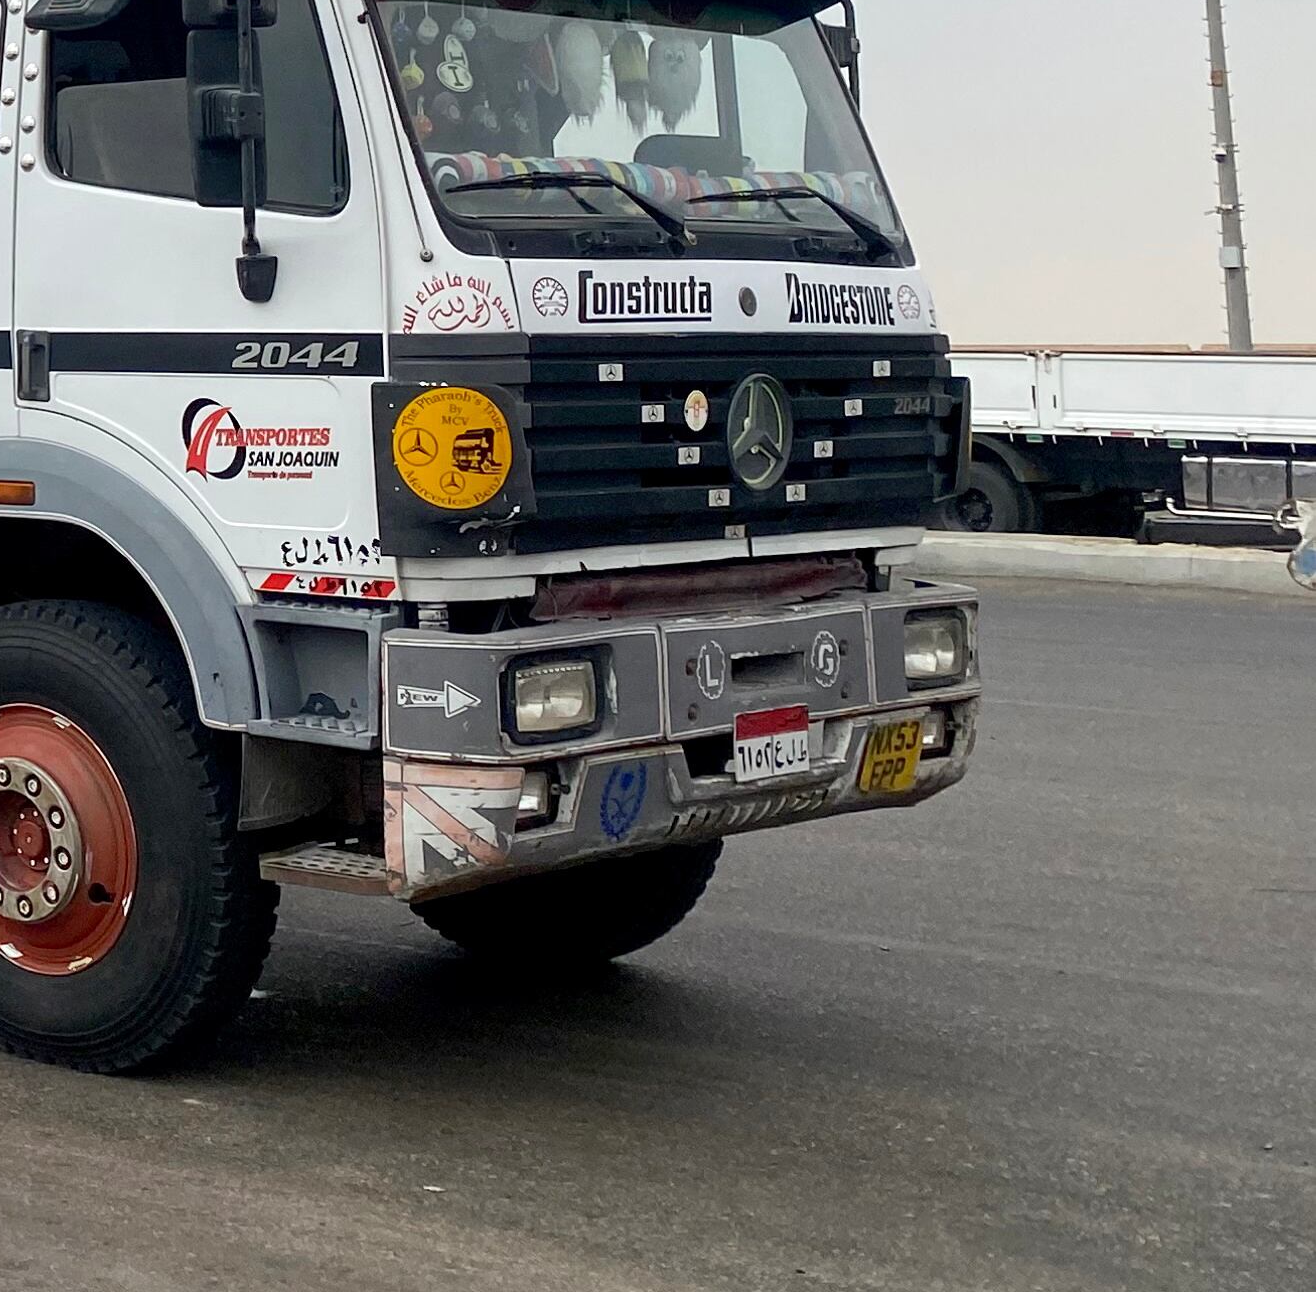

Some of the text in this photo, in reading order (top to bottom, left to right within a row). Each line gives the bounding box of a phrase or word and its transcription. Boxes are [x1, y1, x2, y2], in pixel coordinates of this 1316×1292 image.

[578, 270, 712, 324] Constructa
[785, 272, 895, 326] BRIDGESTONE
[231, 341, 359, 369] 2044
[401, 391, 508, 435] The Pharaoh's Truck
[449, 404, 463, 414] By
[894, 396, 931, 415] 2044
[441, 416, 470, 426] MCV
[216, 428, 330, 447] TRANSPORTES
[248, 451, 340, 468] SAN JOAQUIN
[404, 469, 503, 506] Mercedes Benz
[400, 692, 439, 704] NEW
[868, 721, 921, 755] NX53
